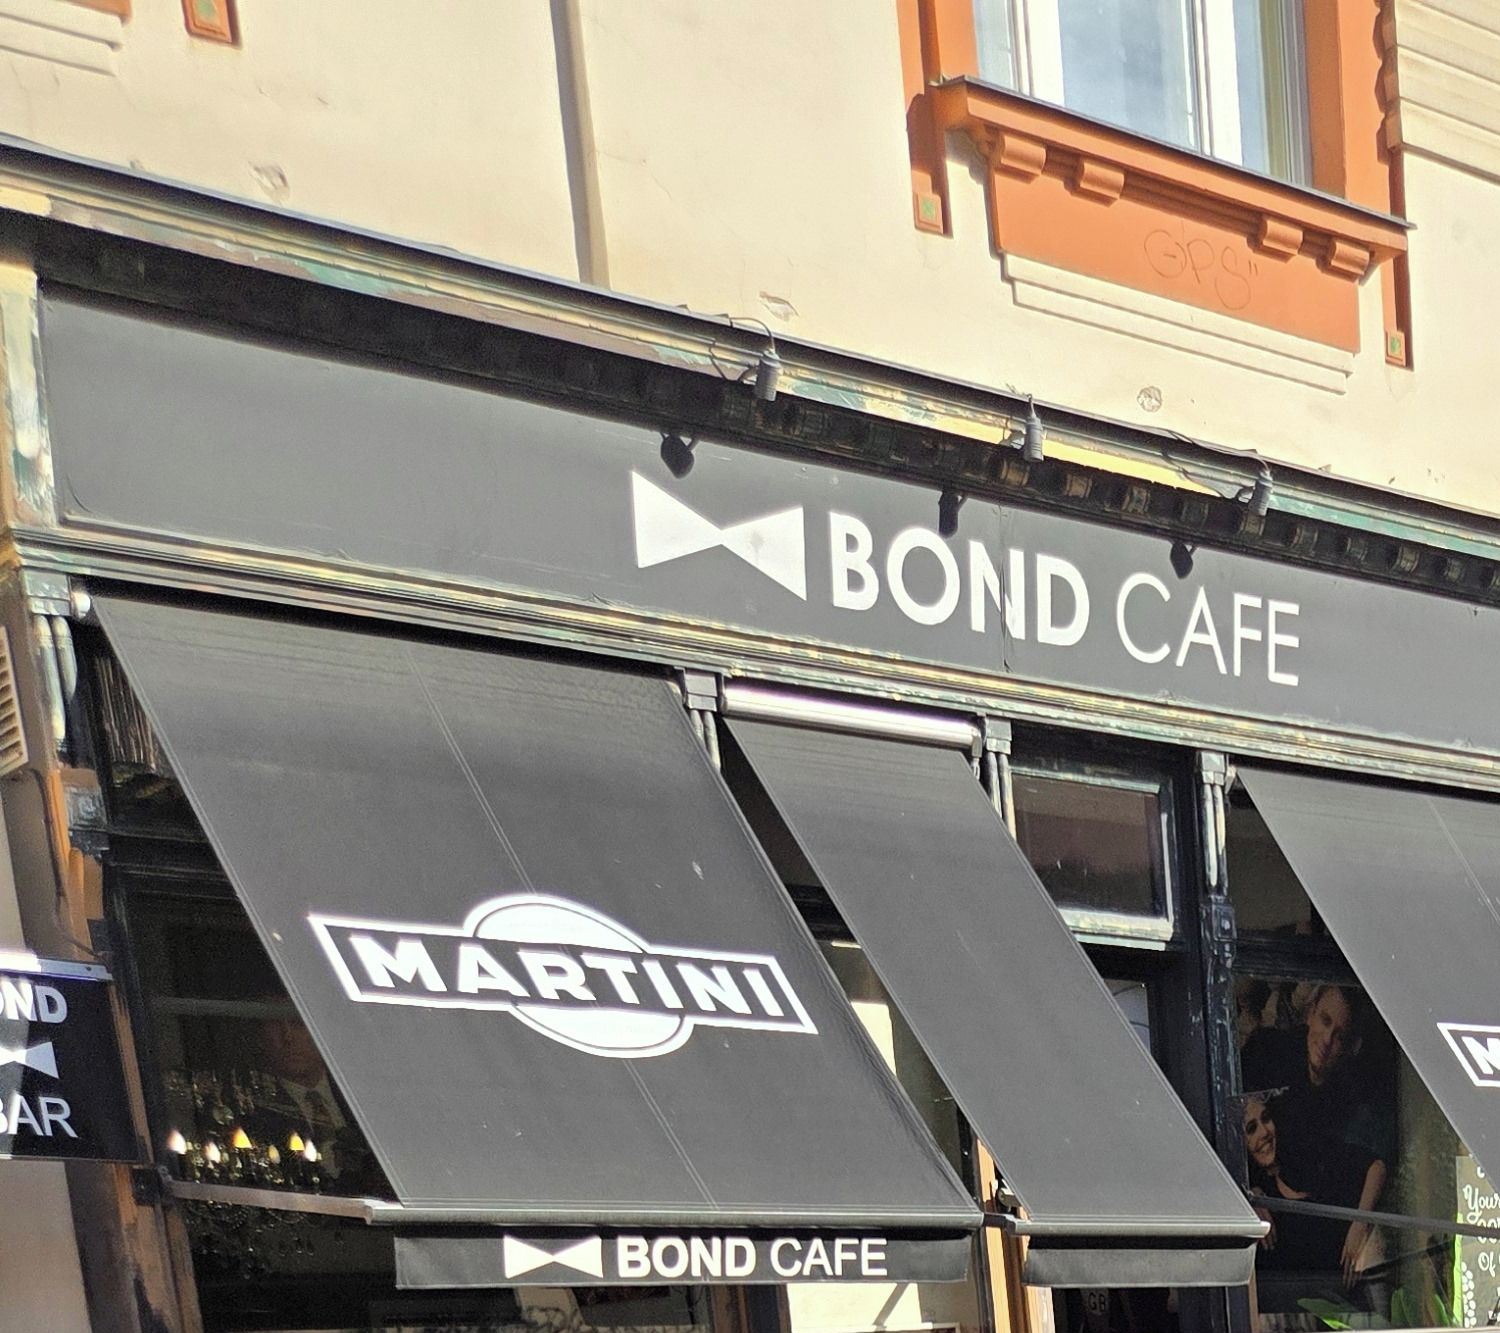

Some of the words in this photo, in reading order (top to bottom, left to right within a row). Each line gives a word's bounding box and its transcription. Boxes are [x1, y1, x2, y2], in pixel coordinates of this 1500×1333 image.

[829, 510, 1090, 648] BOND
[1116, 573, 1300, 687] CAFE
[0, 976, 68, 1024] ND
[348, 932, 785, 1018] MARTINI
[617, 1235, 757, 1278] BOND
[770, 1237, 888, 1277] CAFE
